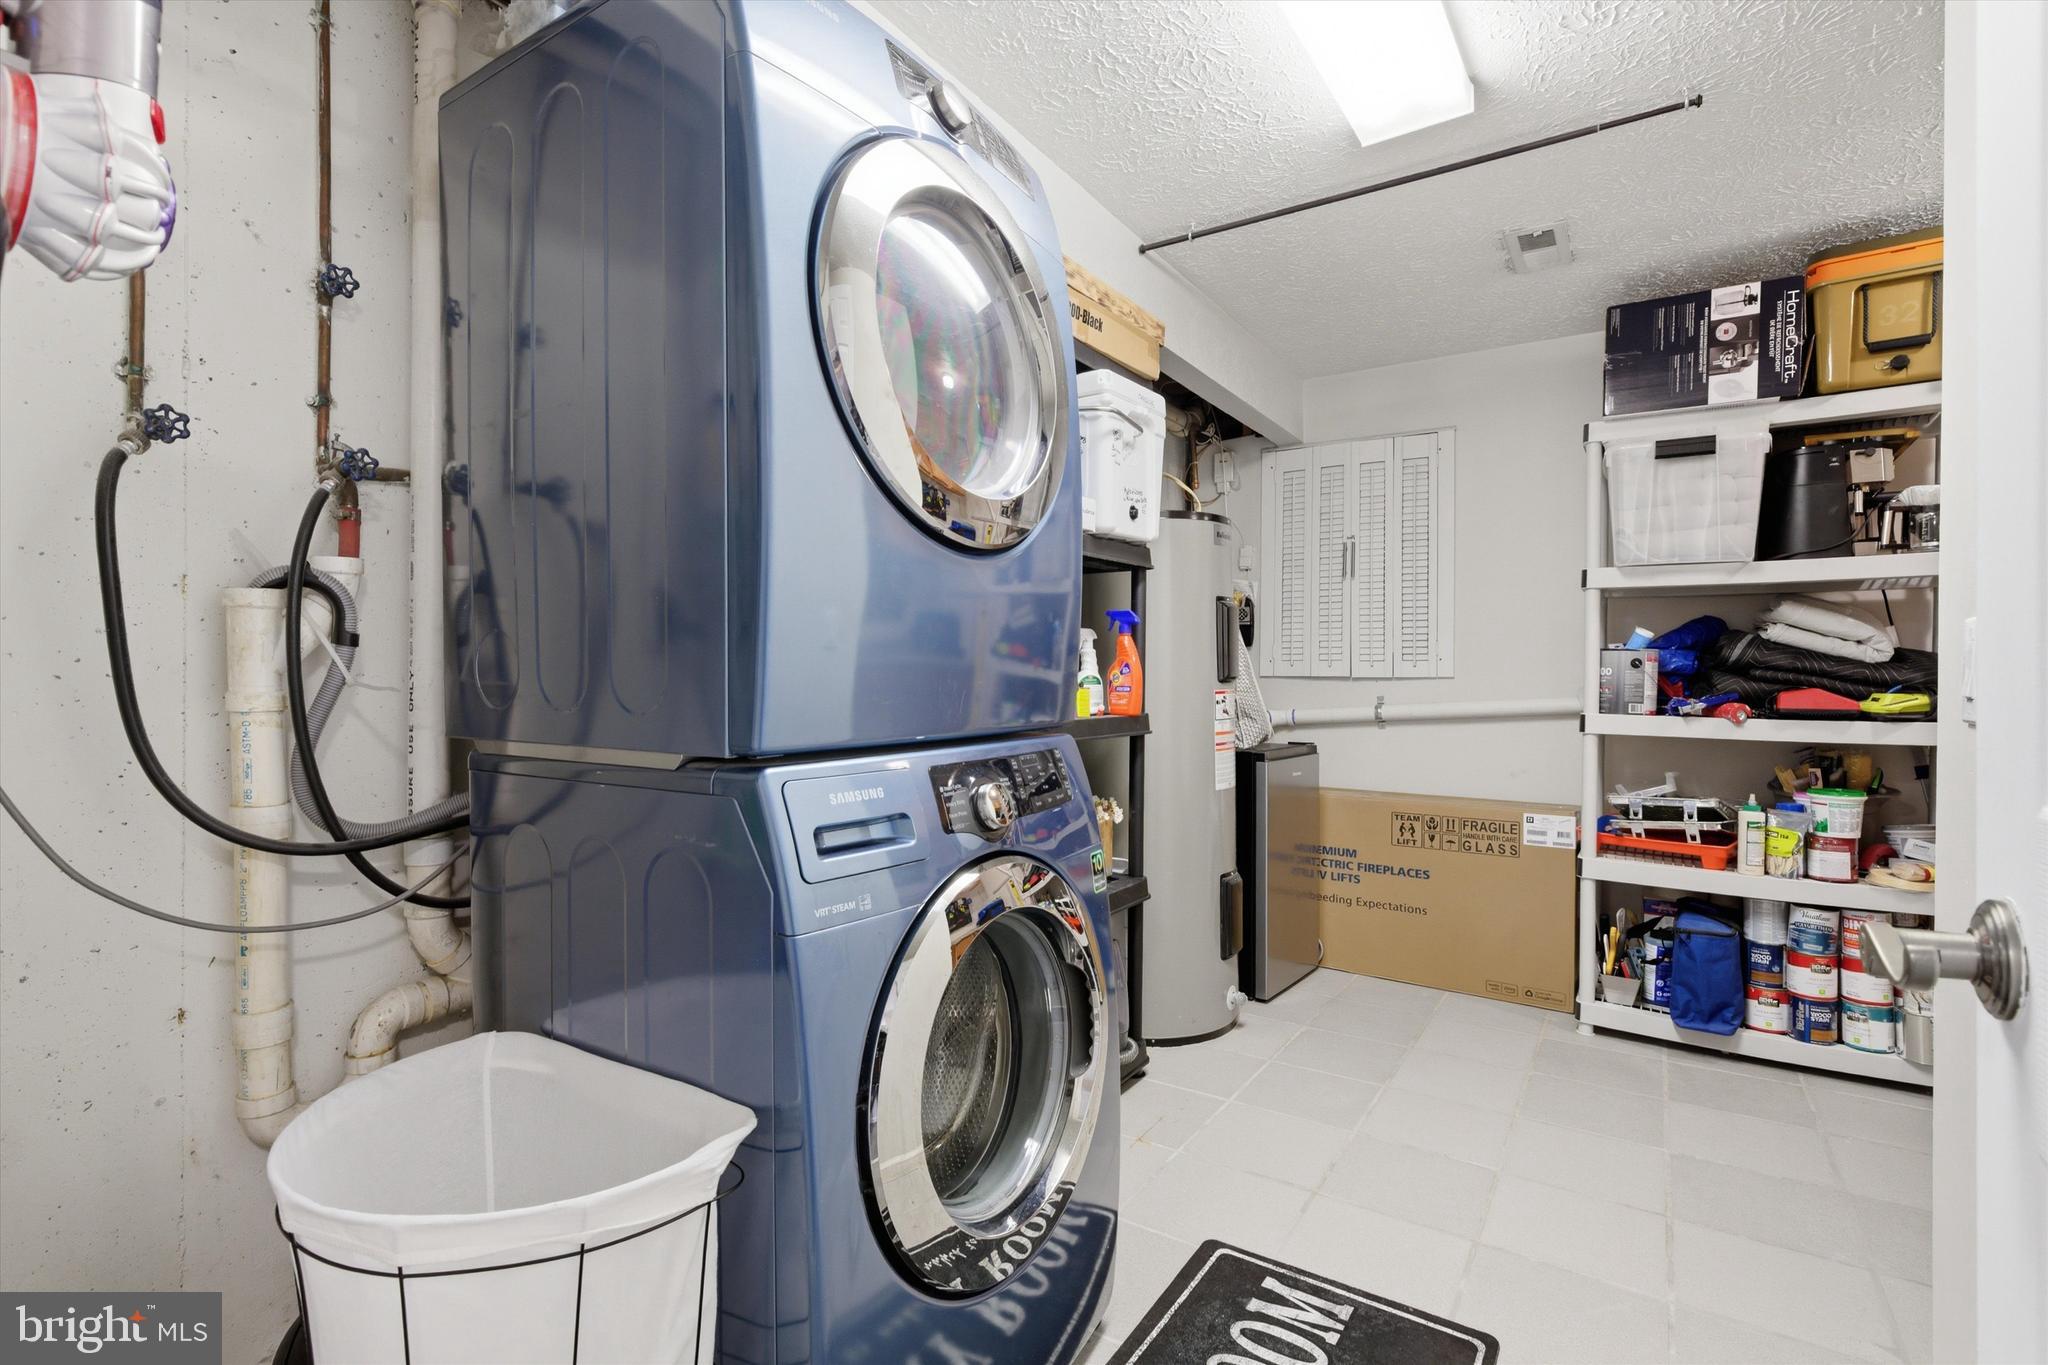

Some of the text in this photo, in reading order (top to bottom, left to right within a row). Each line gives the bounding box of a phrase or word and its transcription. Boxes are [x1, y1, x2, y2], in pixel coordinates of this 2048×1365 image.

[1879, 300, 1921, 327] 32
[1784, 289, 1800, 379] HomeCraft
[828, 786, 885, 805] SAMSUNG
[1394, 814, 1421, 823] TEAM
[1462, 819, 1518, 835] FRAGILE
[1396, 838, 1418, 846] LIFT
[1462, 832, 1486, 841] HANDLE
[1486, 834, 1501, 842] WITH
[1462, 840, 1518, 856] GLASS
[1330, 872, 1361, 884] LIFTS
[1357, 862, 1430, 880] FIREPLACES
[832, 900, 856, 914] STEAM
[1356, 896, 1428, 916] Expectations
